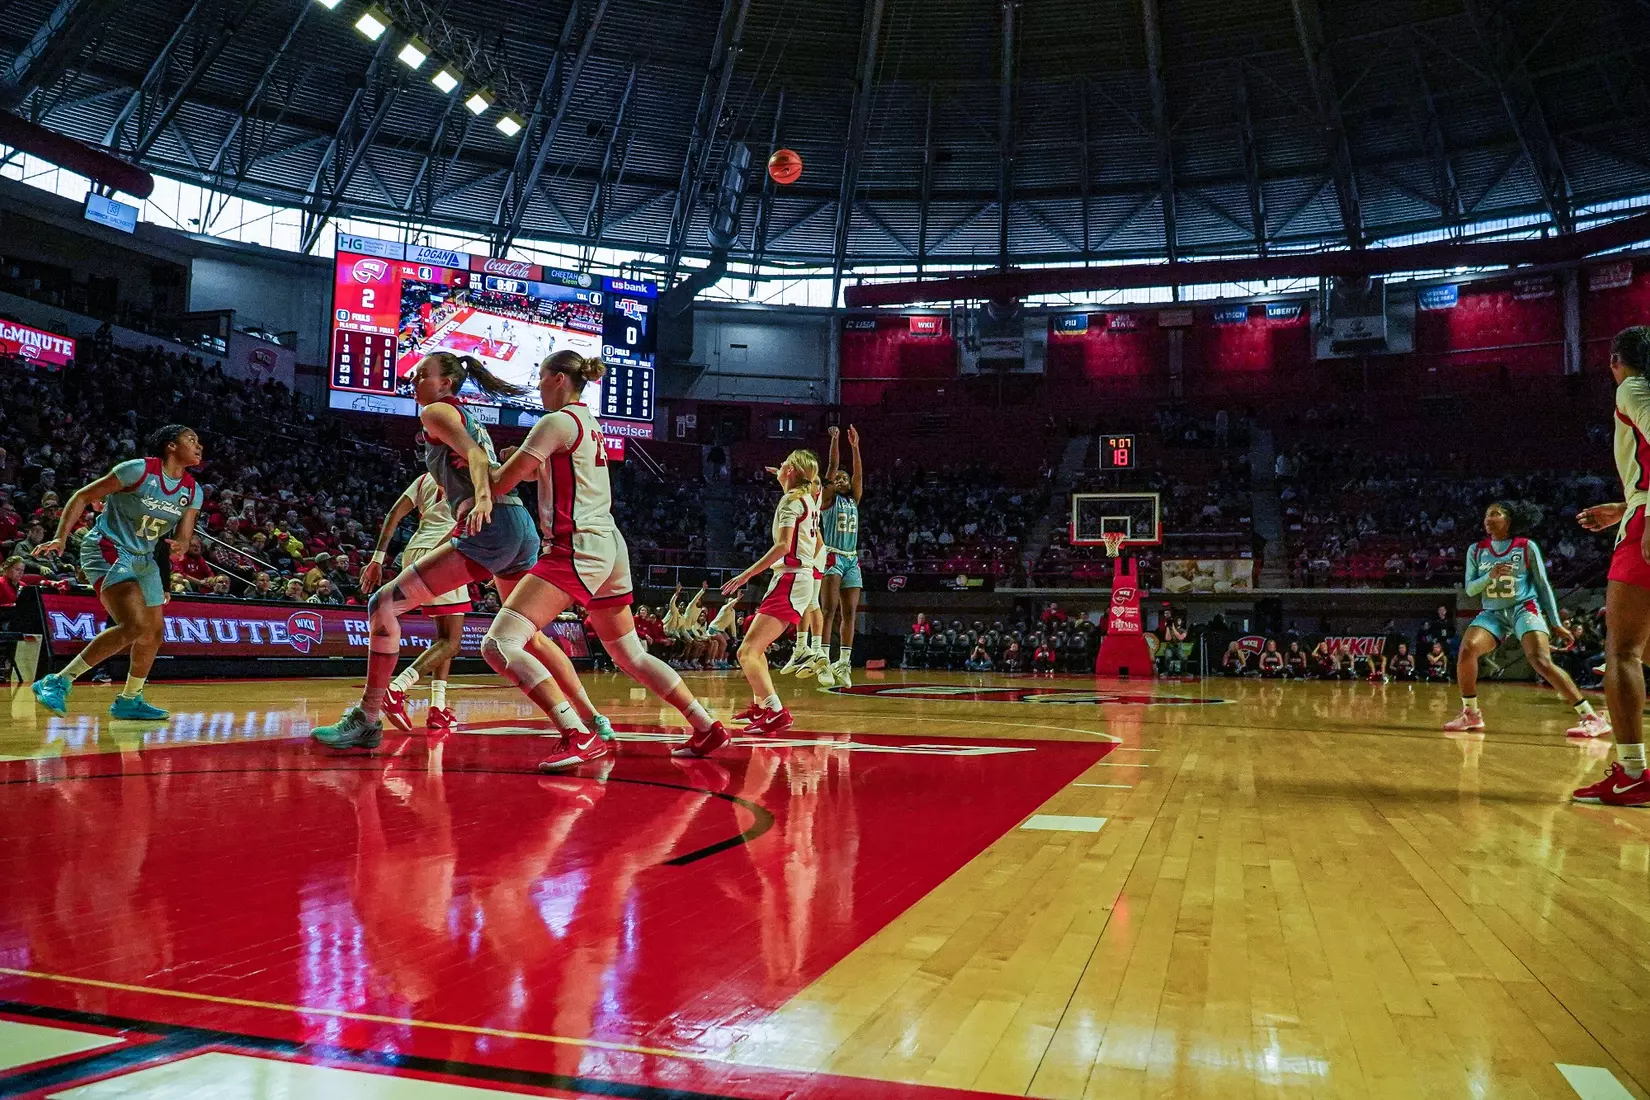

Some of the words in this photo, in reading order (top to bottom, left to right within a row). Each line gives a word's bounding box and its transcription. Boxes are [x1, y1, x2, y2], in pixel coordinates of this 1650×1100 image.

[418, 248, 450, 261] LOGAN
[415, 257, 446, 265] ALUMINUM
[551, 269, 578, 280] CHEETAH
[361, 288, 375, 309] 2
[1268, 306, 1301, 317] LIBERTY
[918, 321, 935, 329] WKU
[1064, 319, 1077, 327] FIU
[627, 326, 637, 345] 0
[343, 344, 350, 353] 3
[339, 364, 351, 373] 23
[611, 367, 617, 376] 3
[339, 375, 350, 385] 33
[480, 413, 497, 423] Dairy
[601, 422, 652, 438] dweiser
[1113, 449, 1128, 466] 18
[136, 514, 168, 541] 15
[837, 512, 857, 533] 22
[1486, 575, 1515, 599] 23
[295, 618, 315, 632] WKU
[410, 635, 432, 650] Fry
